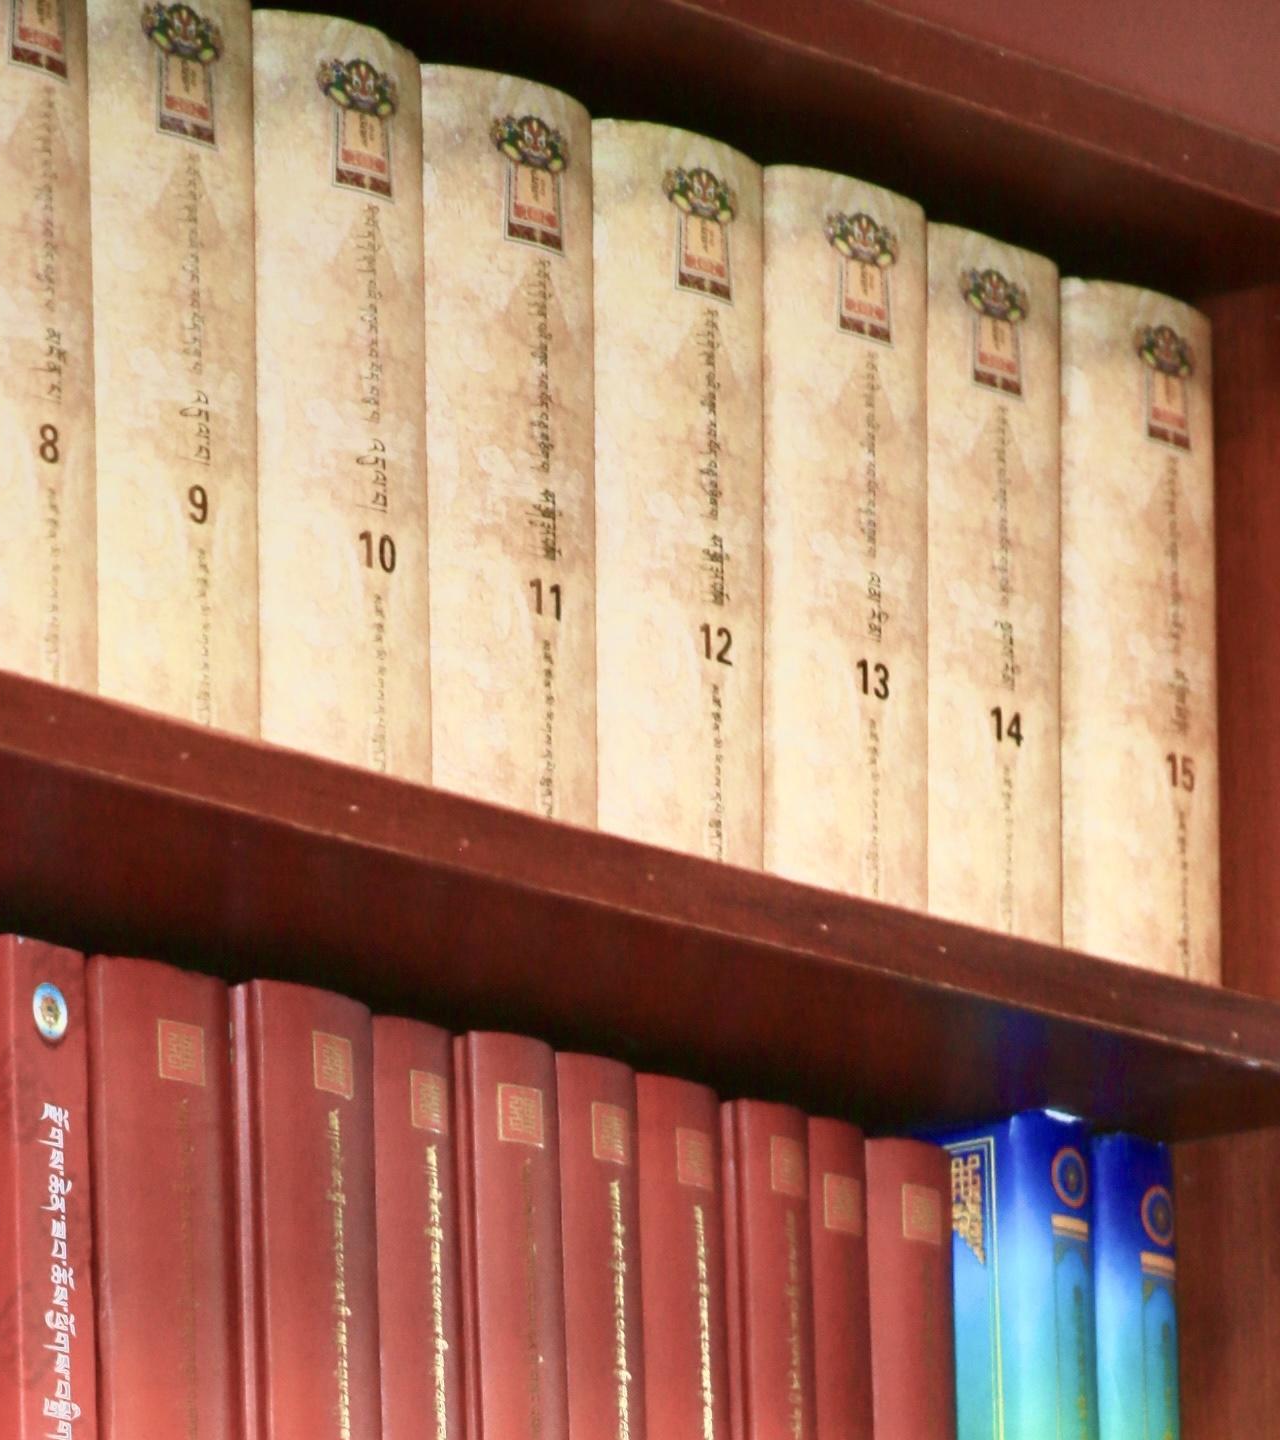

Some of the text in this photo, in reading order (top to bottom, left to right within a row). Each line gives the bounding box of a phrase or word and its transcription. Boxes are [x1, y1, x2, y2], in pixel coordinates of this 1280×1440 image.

[39, 424, 59, 465] 8
[189, 485, 210, 525] 9
[358, 531, 397, 574] 10
[528, 577, 564, 622] 11
[698, 623, 734, 667] 12
[855, 658, 890, 701] 13
[990, 706, 1024, 747] 14
[1166, 752, 1196, 793] 15
